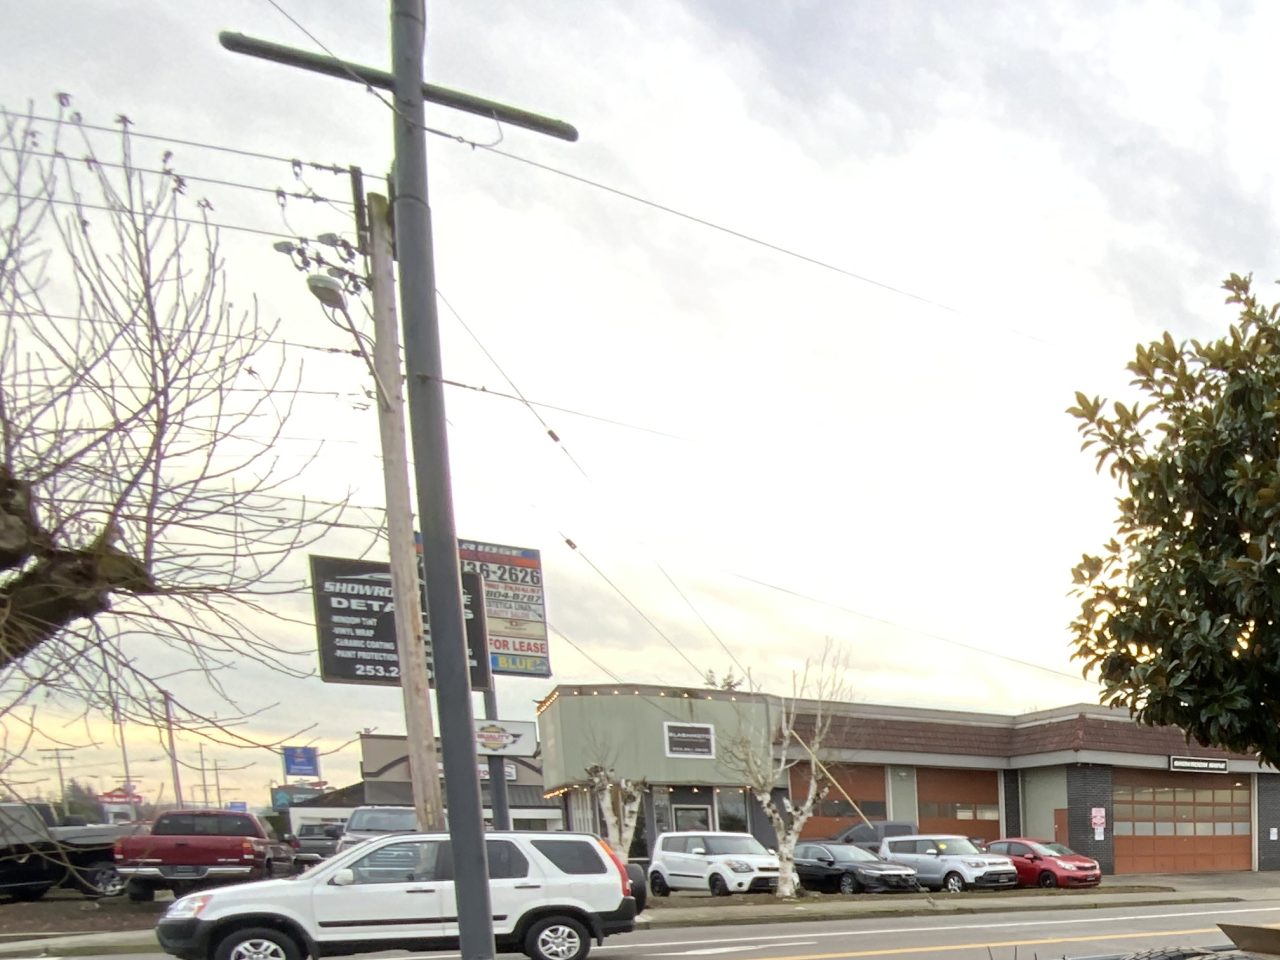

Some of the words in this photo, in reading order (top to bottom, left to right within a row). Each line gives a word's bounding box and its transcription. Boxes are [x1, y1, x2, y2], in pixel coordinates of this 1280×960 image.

[461, 560, 540, 585] 36-2626
[323, 581, 394, 598] SHOWRO
[489, 638, 509, 651] FOR
[513, 641, 547, 654] LEASE
[499, 655, 533, 669] BLUE
